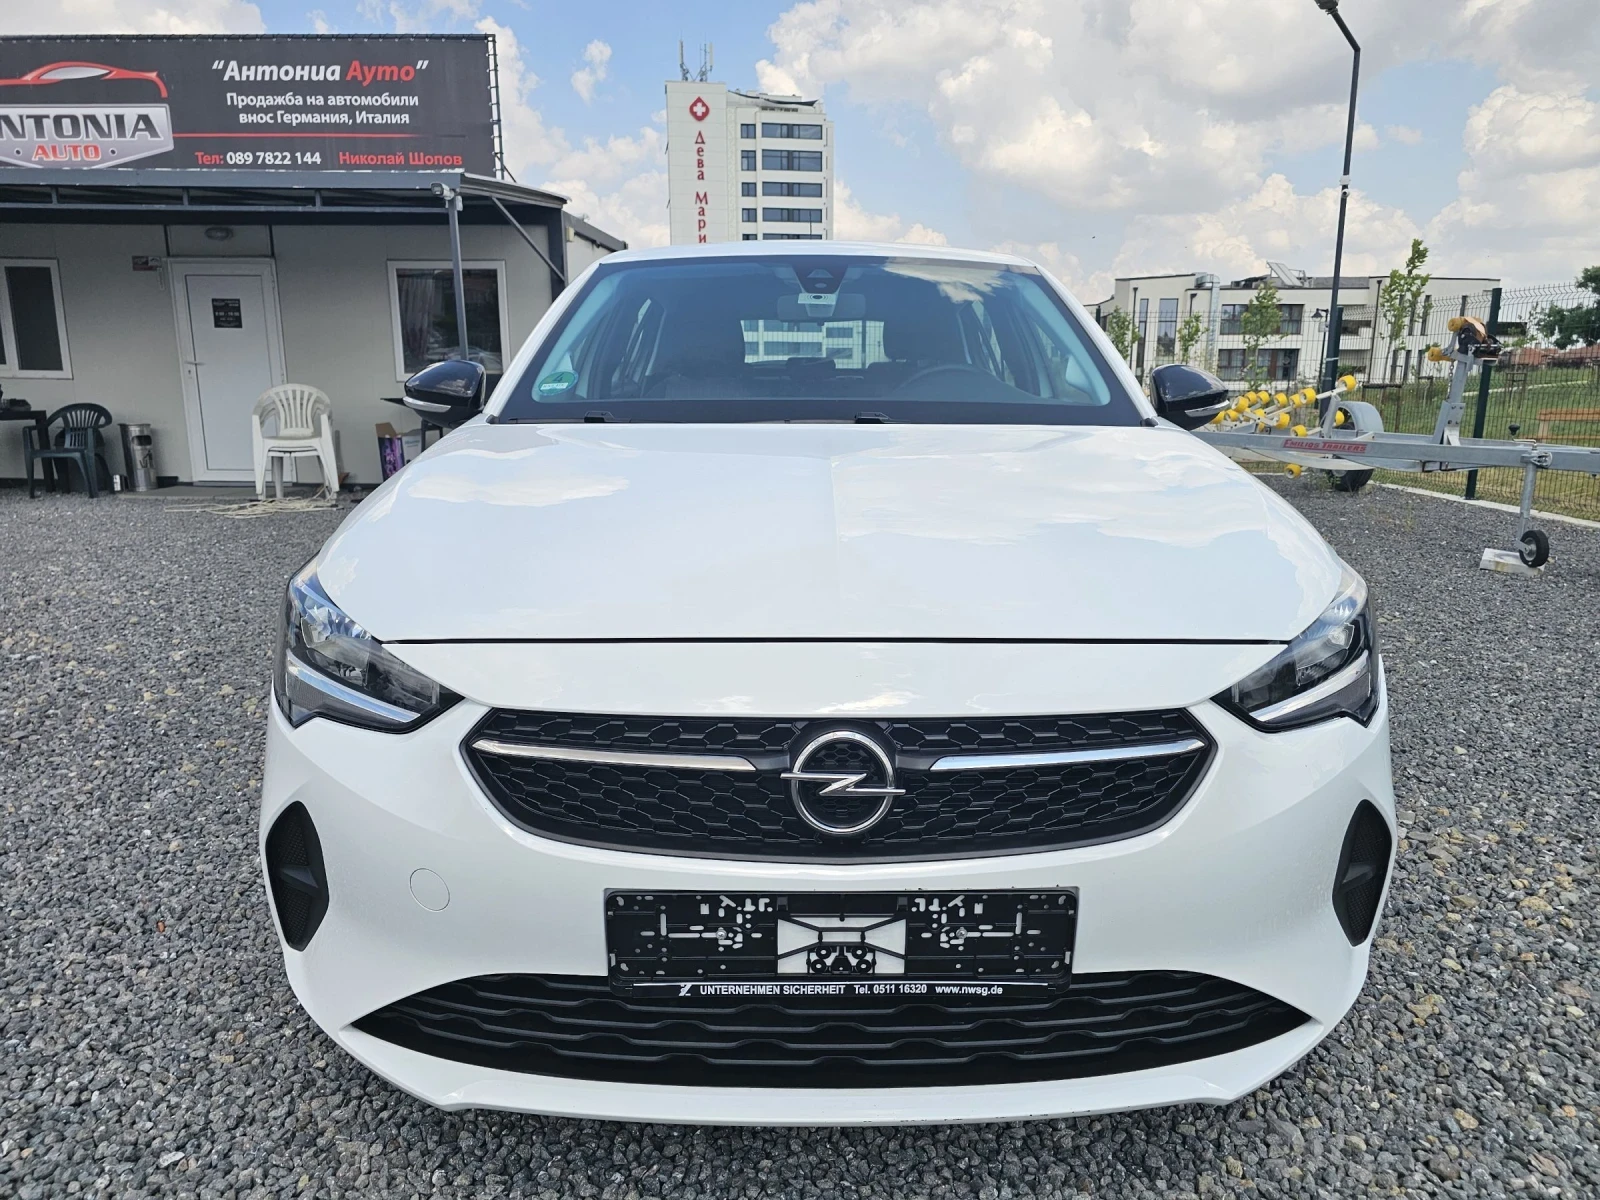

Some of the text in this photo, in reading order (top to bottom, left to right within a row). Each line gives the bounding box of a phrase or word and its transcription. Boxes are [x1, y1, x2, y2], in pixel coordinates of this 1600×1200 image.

[226, 92, 419, 108] Продажба на автомобили
[239, 110, 410, 126] внос Германия, Италия
[33, 144, 101, 160] AUTO
[195, 152, 463, 165] Тел: 089 7822 144 Николай Шопов
[694, 130, 706, 181] Дева
[1284, 439, 1367, 453] EMILIOS TRAILERS
[700, 984, 1003, 996] UNTERNEHMEN SICHERHEIT Tel. 0511 16320 www.nwsg.de
